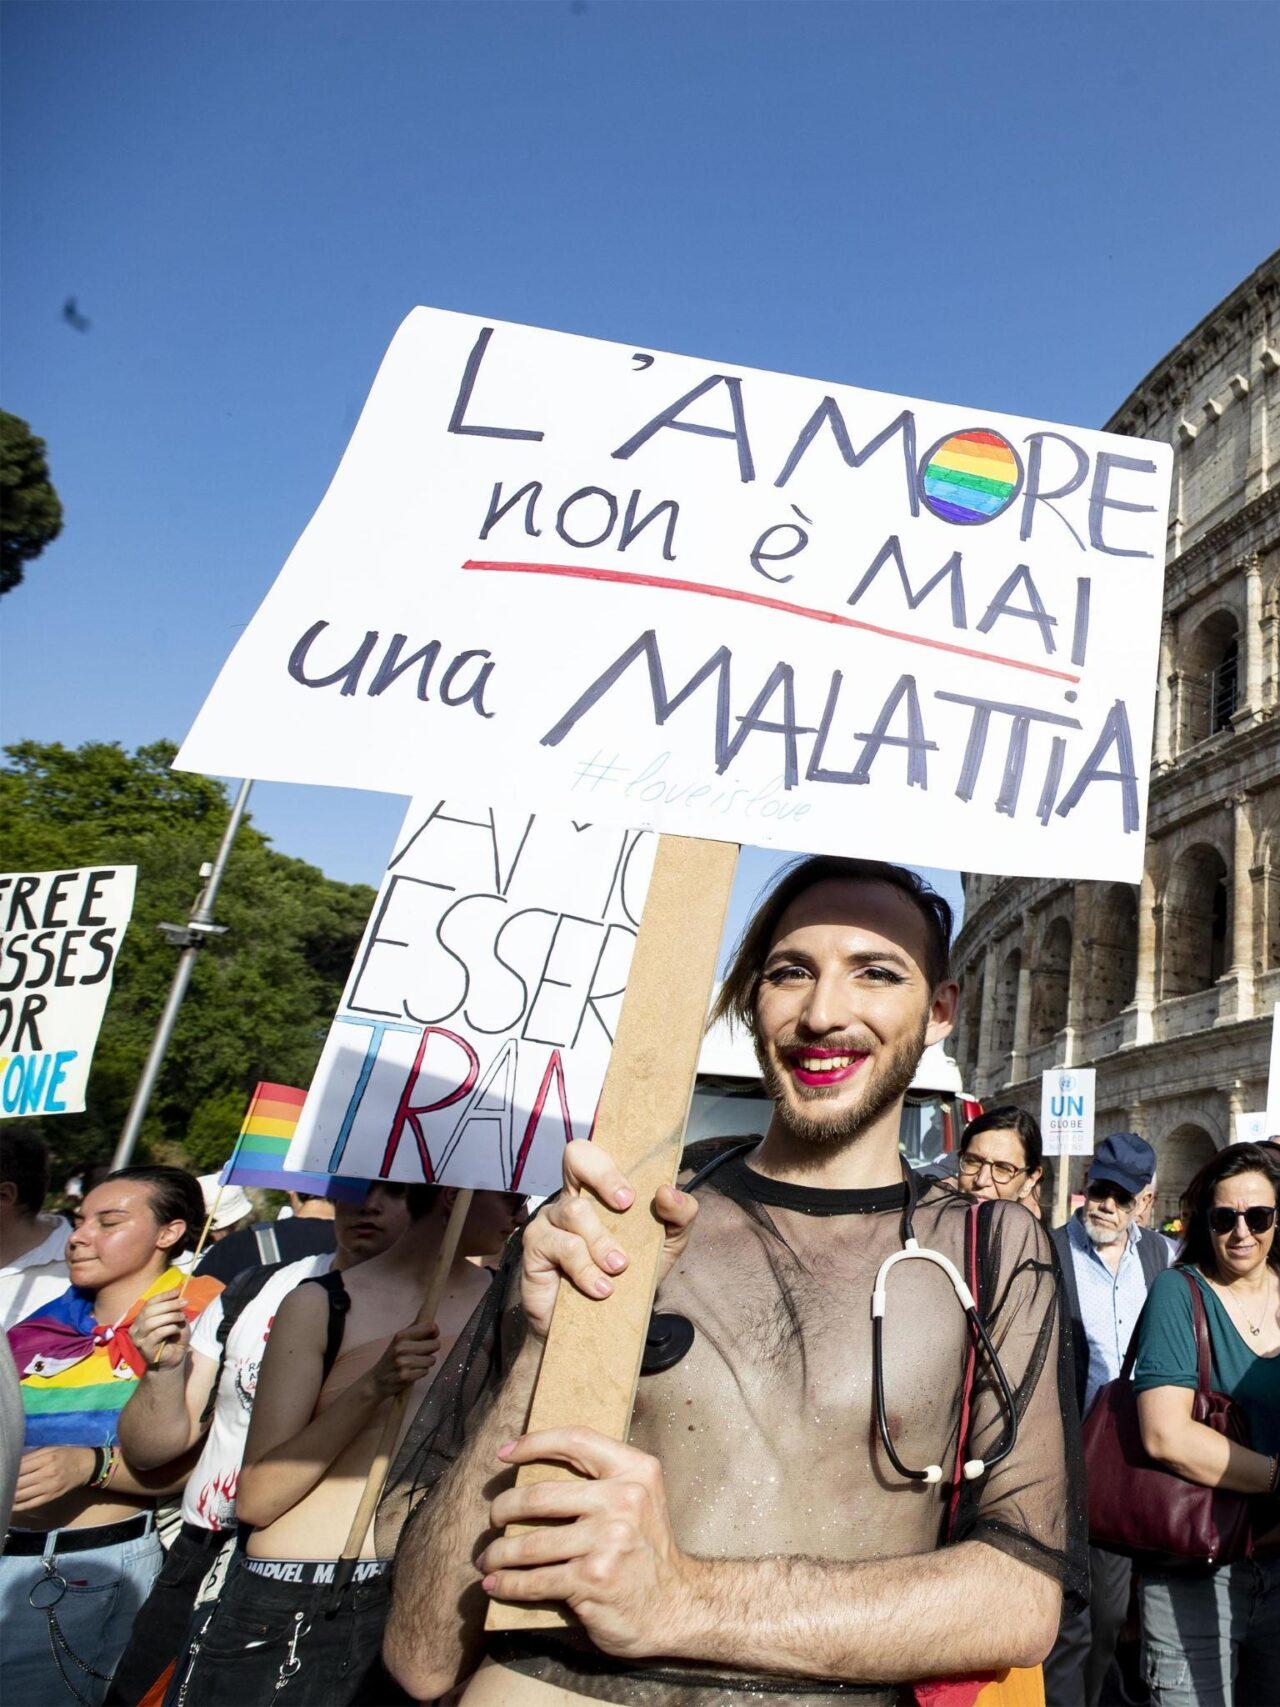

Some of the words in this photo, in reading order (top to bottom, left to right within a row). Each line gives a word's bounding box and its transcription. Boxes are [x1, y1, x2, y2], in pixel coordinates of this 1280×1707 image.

[447, 326, 1158, 559] L'AMORE
[479, 480, 677, 560] non
[749, 503, 812, 583] è
[846, 534, 1091, 667] MAI
[286, 619, 496, 718] una
[0, 927, 117, 992] SSES
[1049, 1119, 1084, 1129] GLOBE
[1050, 1095, 1083, 1117] UN
